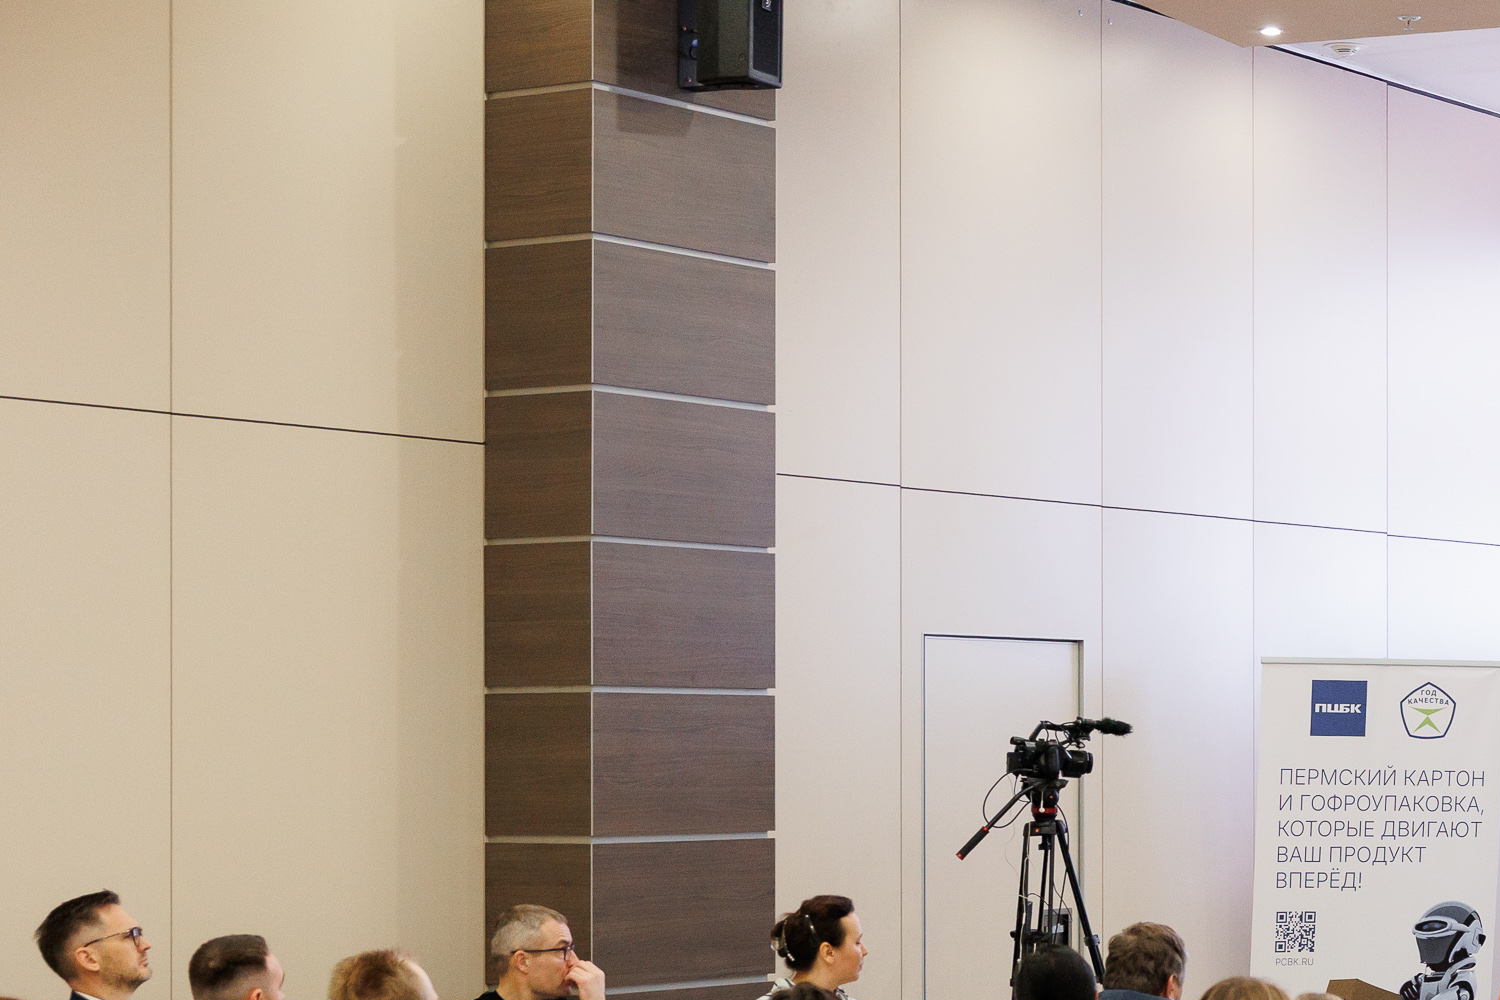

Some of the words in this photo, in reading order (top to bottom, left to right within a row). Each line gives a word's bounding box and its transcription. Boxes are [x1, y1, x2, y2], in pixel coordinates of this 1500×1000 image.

[1407, 697, 1450, 706] КАЧЕСТВА
[1420, 689, 1437, 697] ГОД
[1314, 703, 1362, 714] ПЦБК
[1279, 765, 1397, 786] ПЕРМСКИЙ
[1403, 769, 1485, 787] КАРТОН
[1279, 794, 1292, 811] И
[1300, 793, 1484, 815] ГОФРОУПАКОВКА,
[1278, 820, 1375, 837] КОТОРЫЕ
[1381, 820, 1483, 840] ДВИГАЮТ
[1276, 846, 1322, 863] ВАШ
[1329, 846, 1427, 865] ПРОДУКТ
[1275, 867, 1363, 891] ВПЕРЁД!
[1275, 957, 1315, 967] PCBK.RU
